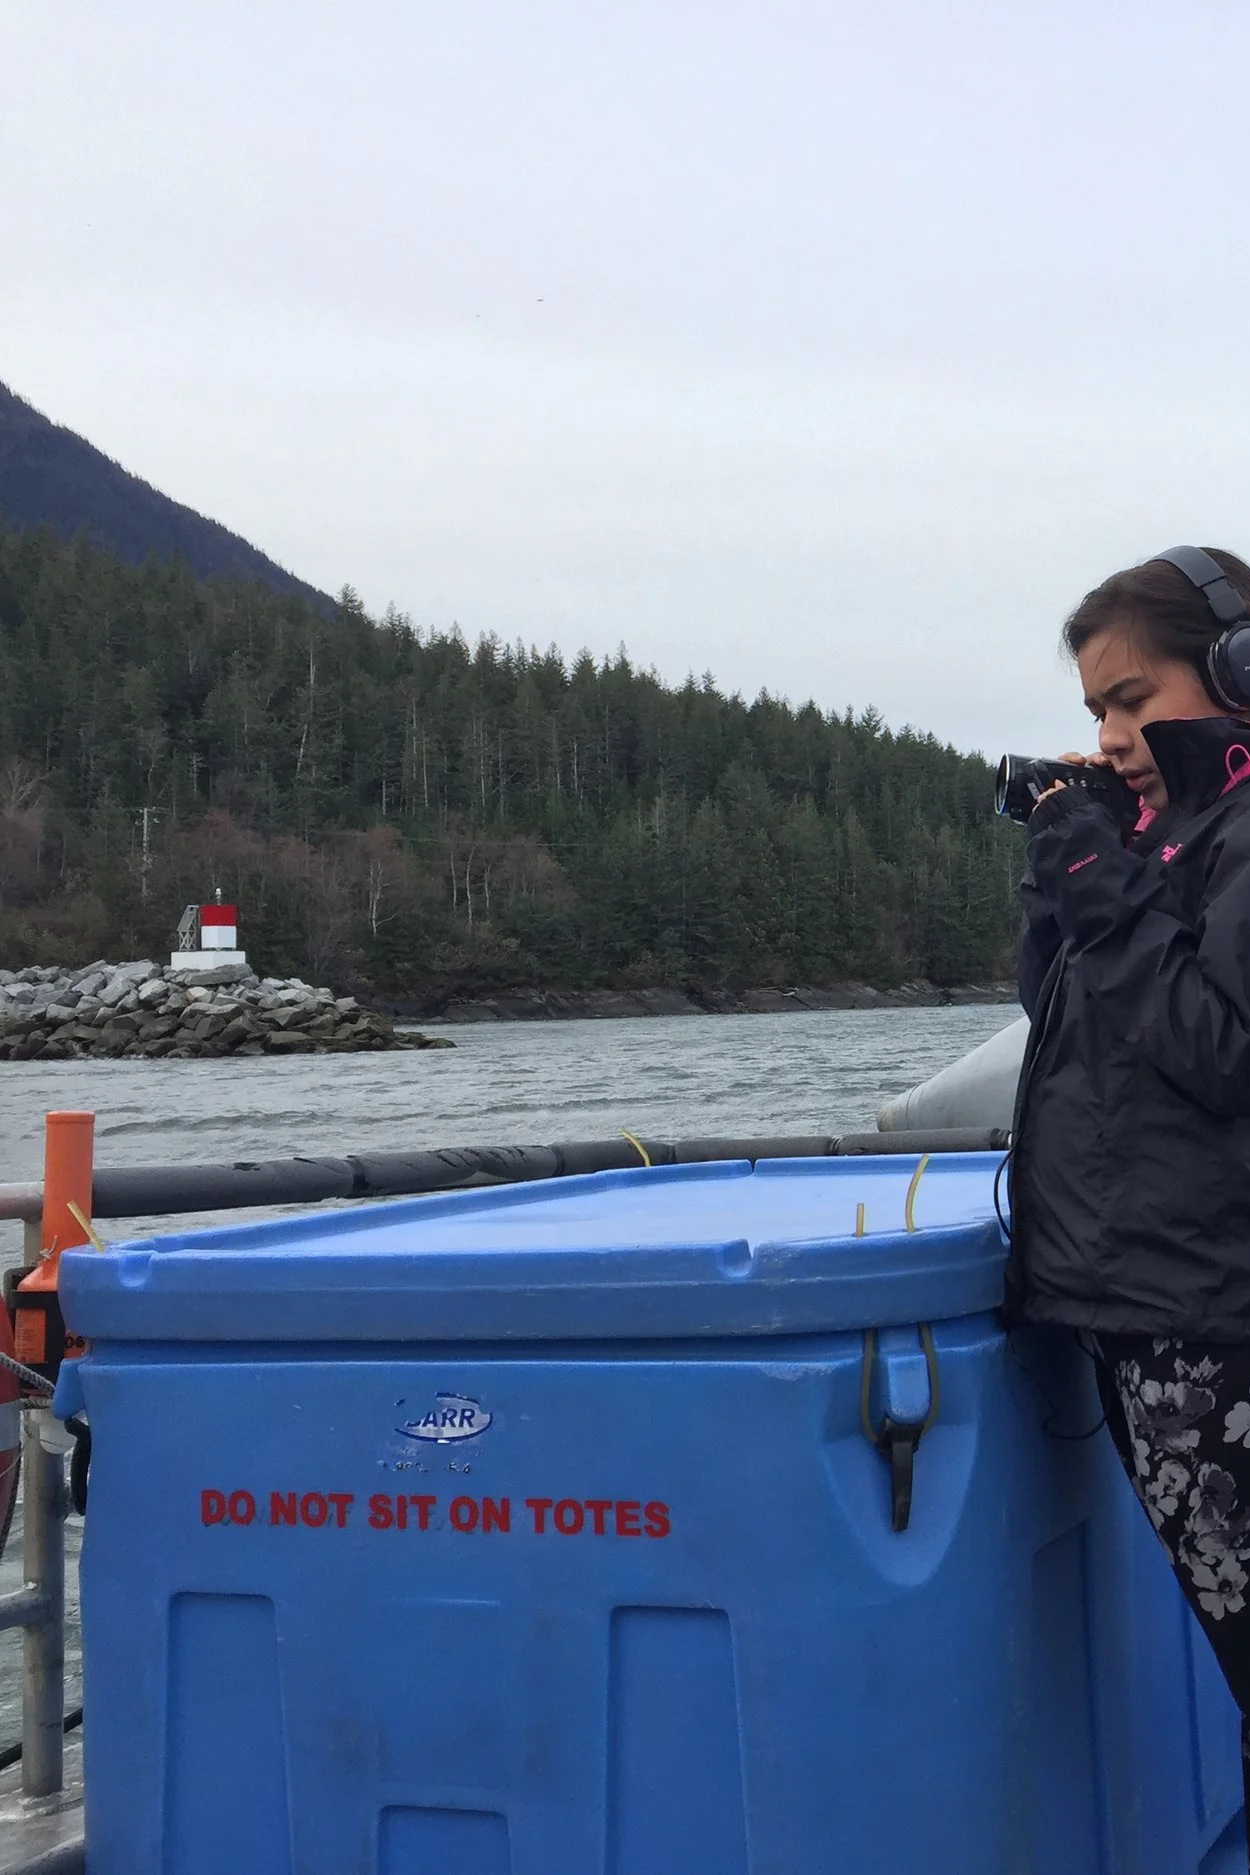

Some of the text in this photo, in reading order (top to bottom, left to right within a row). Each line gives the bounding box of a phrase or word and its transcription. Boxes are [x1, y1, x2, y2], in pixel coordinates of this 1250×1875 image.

[200, 1489, 671, 1539] DO NOT SIT ON TOTES
